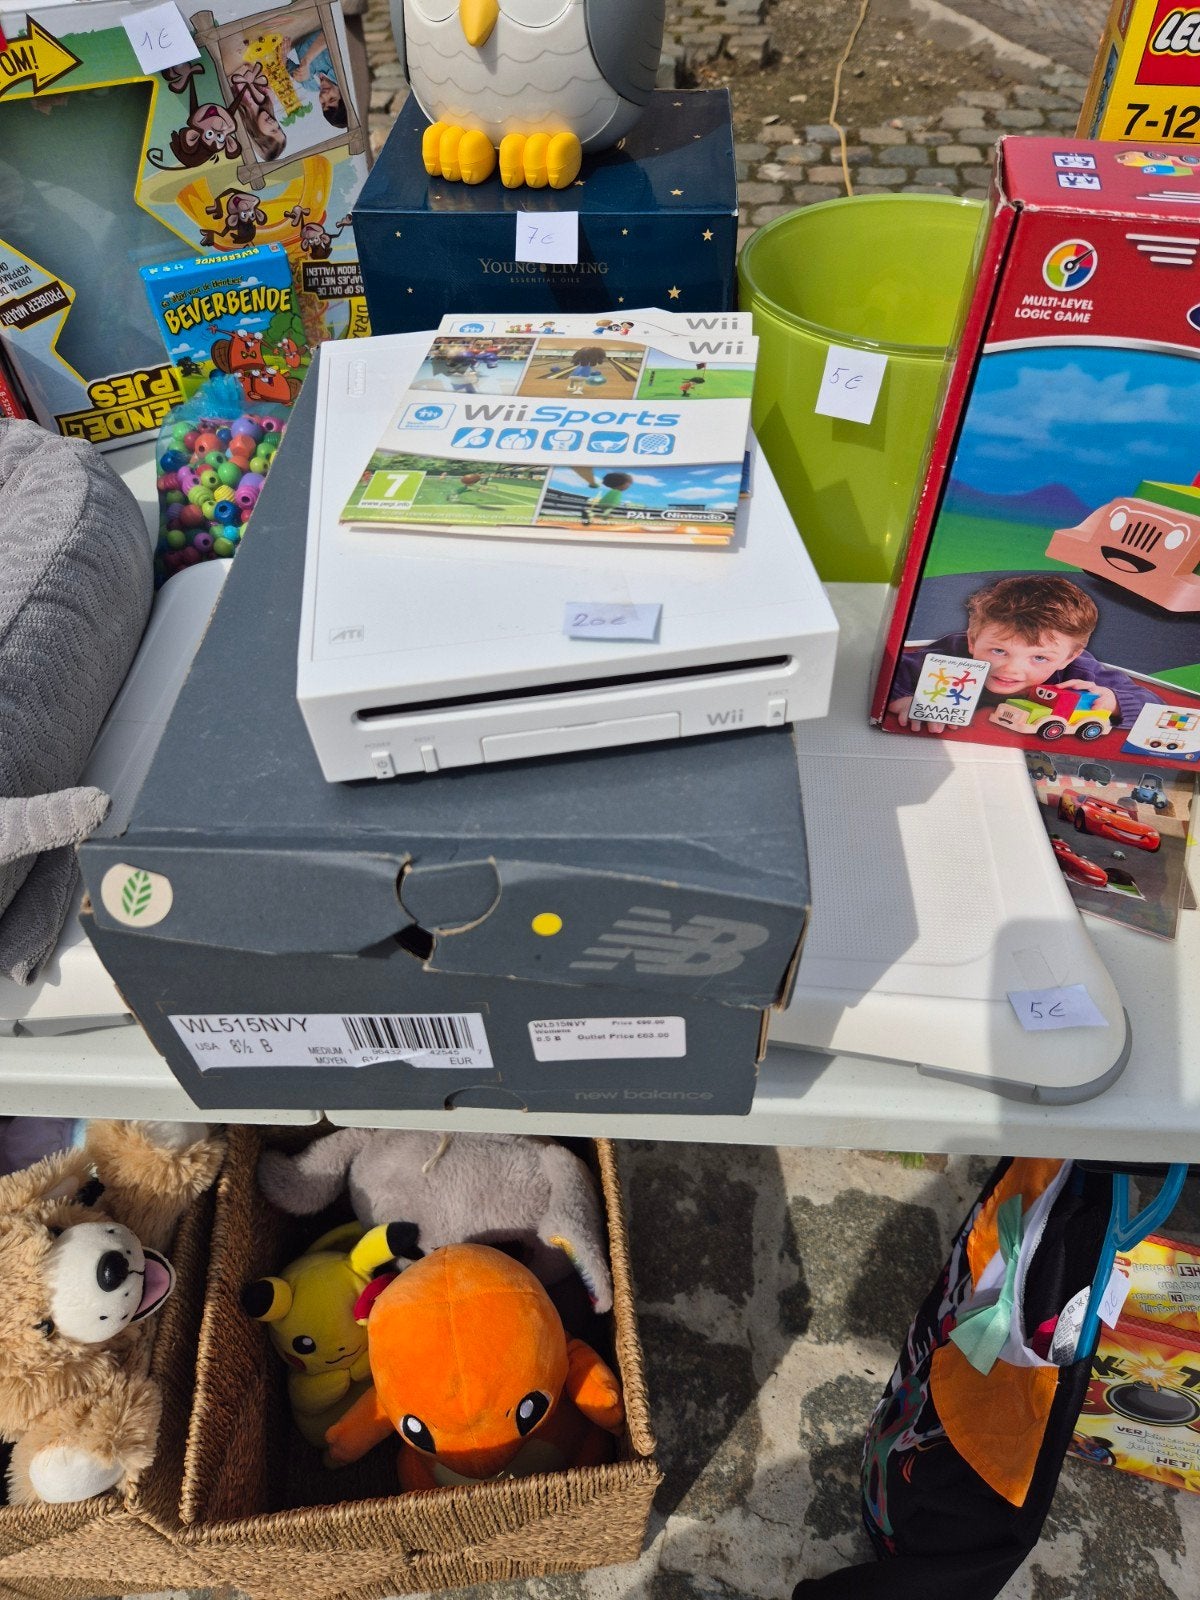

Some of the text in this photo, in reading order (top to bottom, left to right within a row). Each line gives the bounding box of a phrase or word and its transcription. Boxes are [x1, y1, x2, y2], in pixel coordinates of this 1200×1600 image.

[1124, 103, 1200, 138] 7-12
[306, 266, 336, 276] VALLEN!
[337, 266, 357, 275] BOOM
[477, 258, 610, 274] YOUNG LIVING
[8, 276, 33, 291] DRAAI
[321, 276, 336, 285] NIET
[329, 286, 342, 295] DAT
[1, 287, 66, 325] PROBEER MAAR!
[1022, 294, 1094, 311] MULTI-LEVEL
[164, 286, 291, 335] BEVERBENDE
[1014, 307, 1091, 323] LOGIC GAME
[686, 317, 738, 330] Wii
[689, 341, 744, 354] Wii
[464, 404, 681, 428] Wii Sports
[384, 474, 408, 498] 7
[626, 511, 655, 520] PAL
[667, 512, 723, 521] Nintendo
[914, 703, 969, 717] SMART
[707, 708, 744, 726] Wii
[913, 711, 966, 724] GAMES
[179, 1017, 308, 1033] WL515NVY
[195, 1042, 220, 1051] USA
[259, 1038, 273, 1053] B
[308, 1046, 343, 1055] MEDIUM
[450, 1057, 473, 1065] EUR
[575, 1089, 715, 1100] new balance
[1179, 1264, 1200, 1277] HET
[1171, 1294, 1183, 1303] EN
[1156, 1456, 1190, 1468] HET
